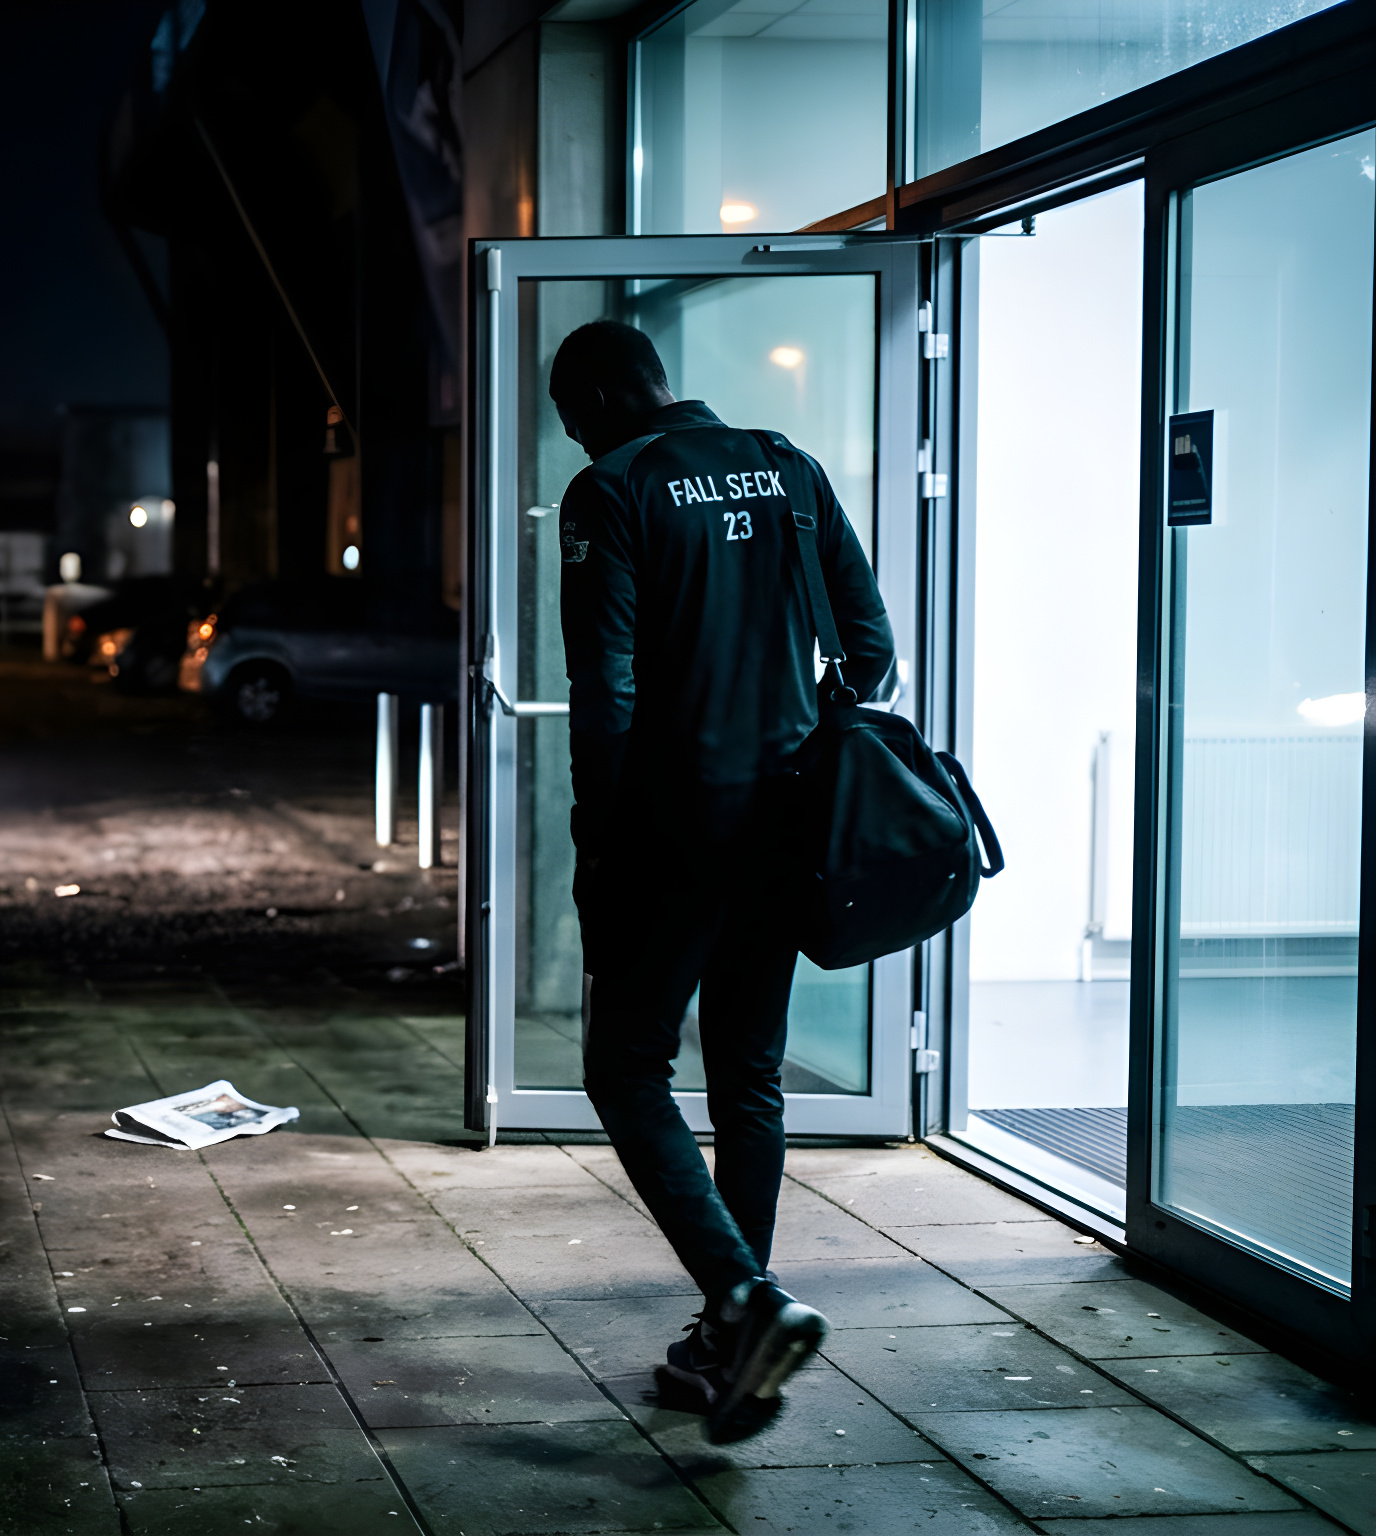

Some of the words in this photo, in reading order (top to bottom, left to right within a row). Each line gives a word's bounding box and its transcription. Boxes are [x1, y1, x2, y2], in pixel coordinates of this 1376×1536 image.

[667, 475, 724, 507] FALL
[725, 470, 787, 500] SECK
[723, 510, 754, 541] 23
